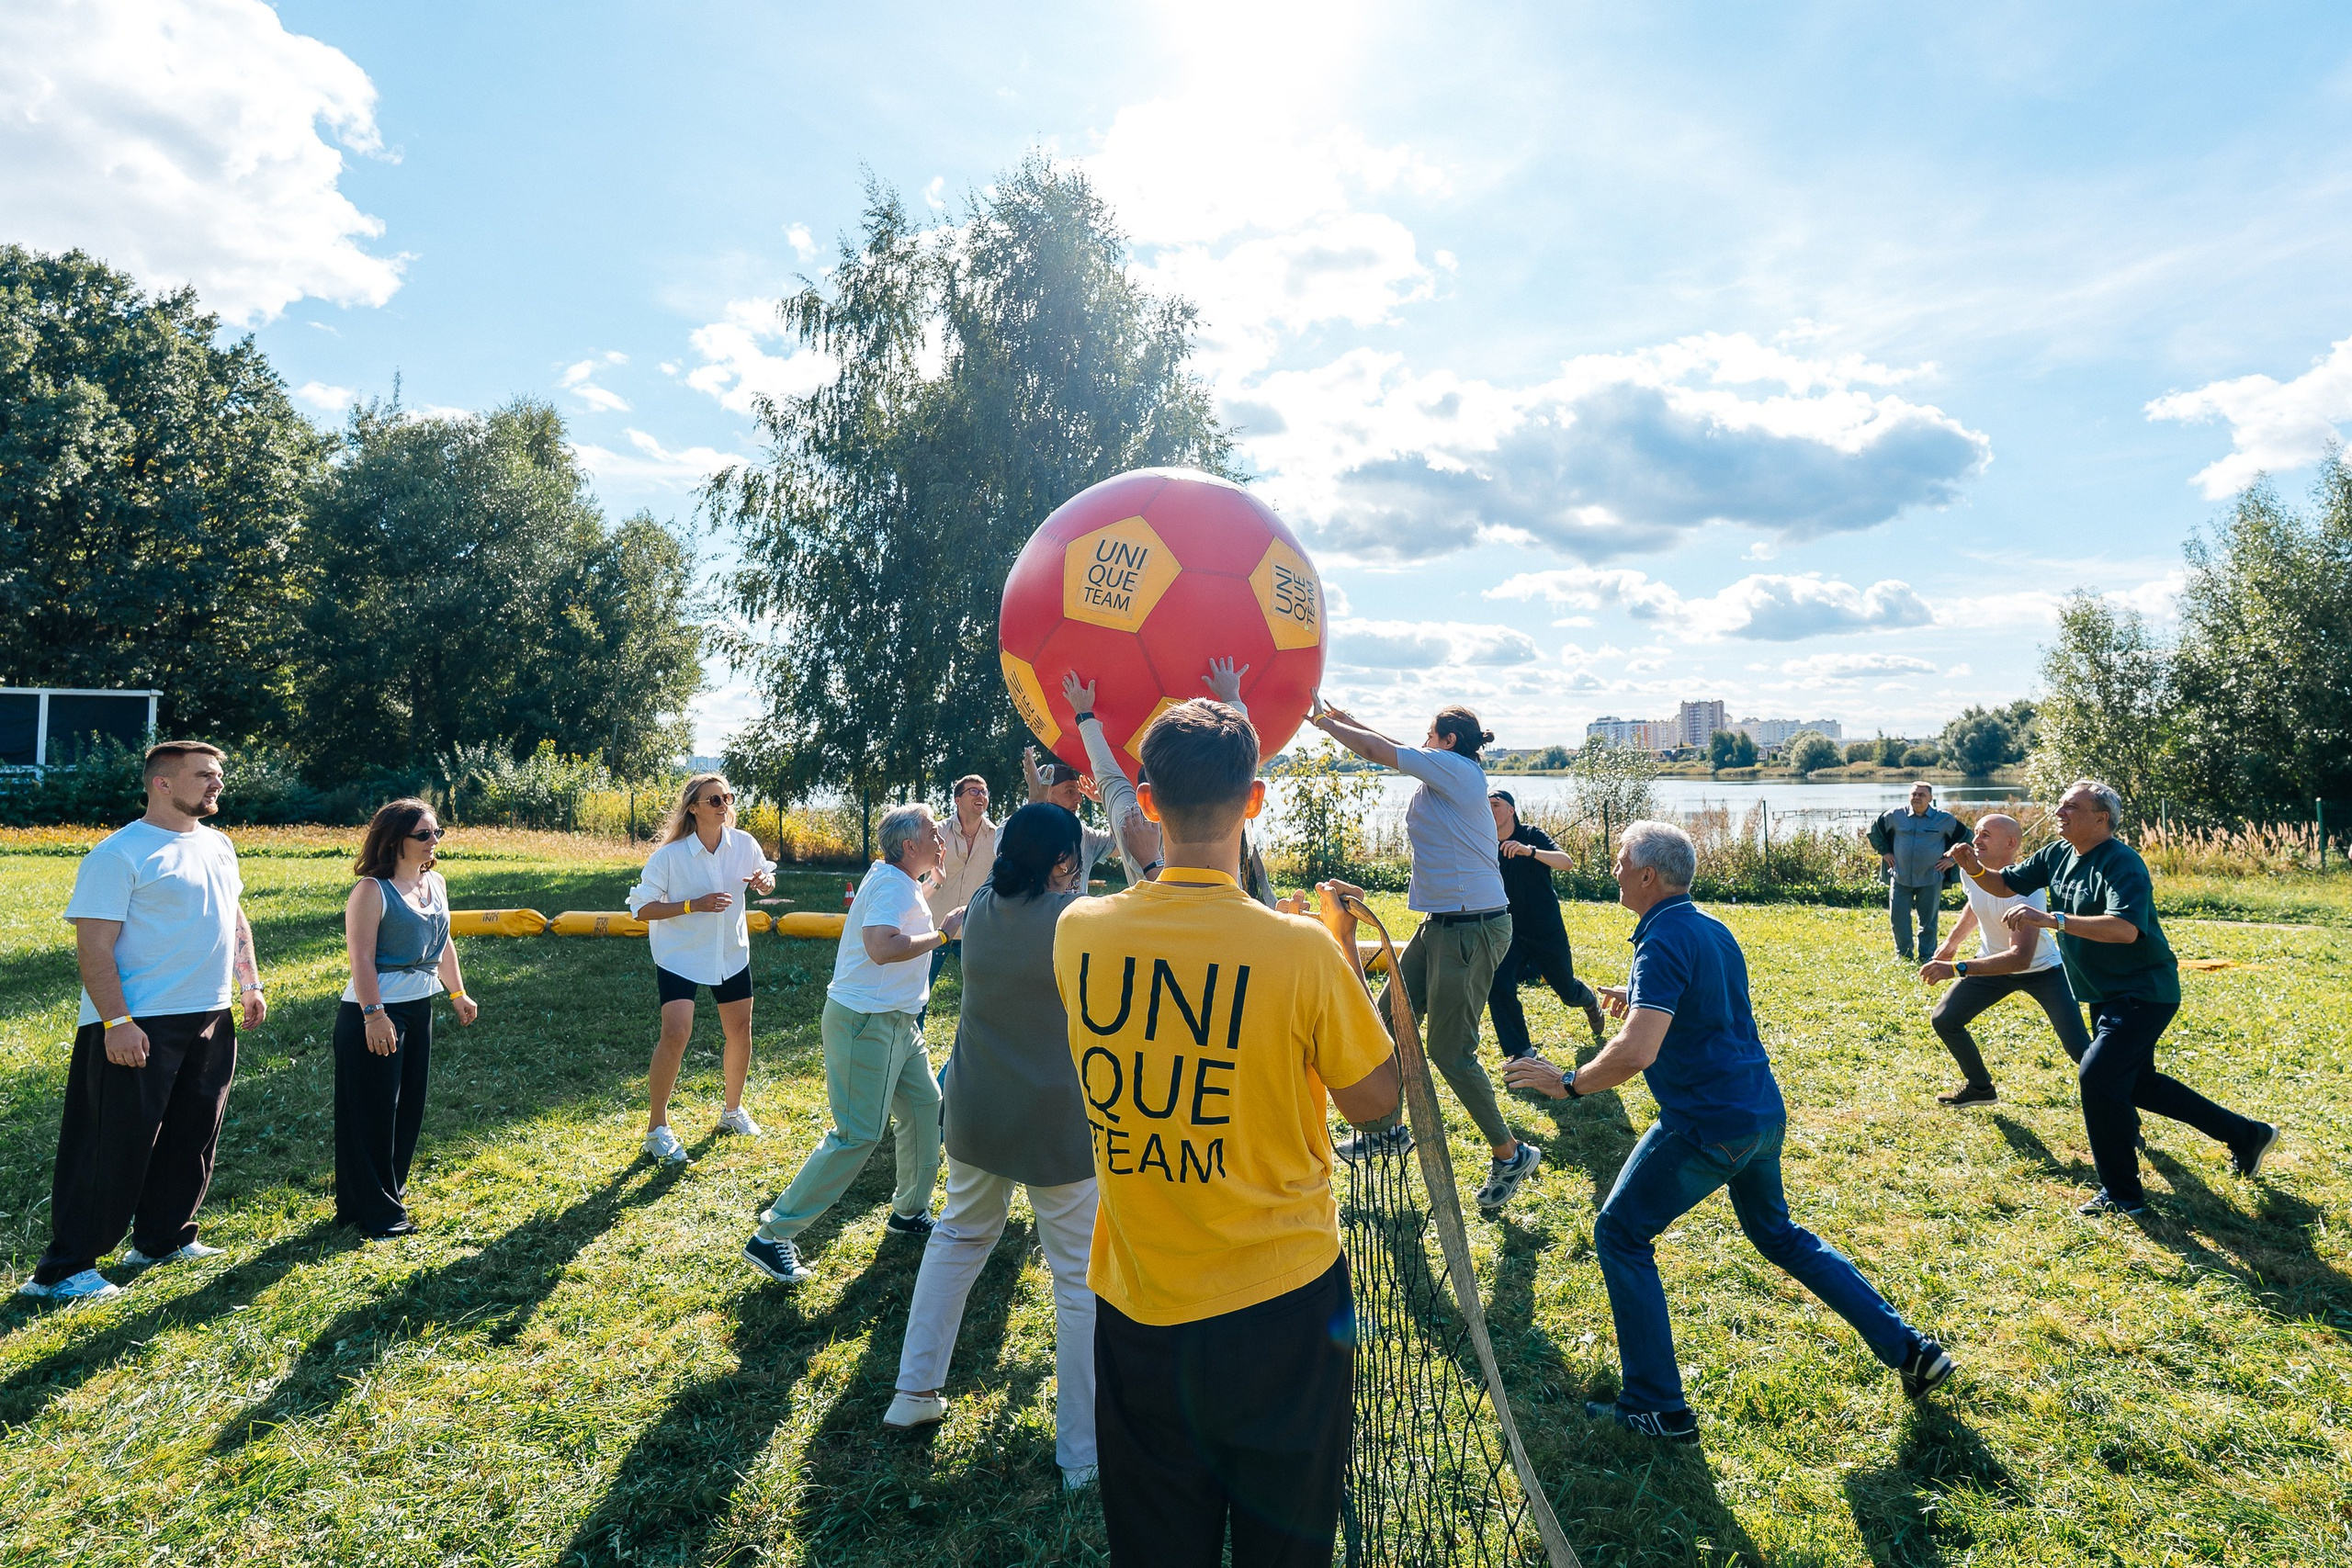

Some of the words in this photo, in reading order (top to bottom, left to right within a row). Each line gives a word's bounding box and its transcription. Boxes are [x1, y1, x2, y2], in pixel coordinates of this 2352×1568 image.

[1088, 564, 1138, 592] QUE
[1096, 539, 1148, 570] UNI
[1084, 586, 1131, 612] TEAM
[1275, 564, 1293, 615] UNI
[1293, 572, 1307, 621] QUE
[1306, 580, 1316, 625] TEAM
[1080, 953, 1250, 1050] UNI
[1081, 1046, 1236, 1125] QUE
[1089, 1119, 1227, 1184] TEAM
